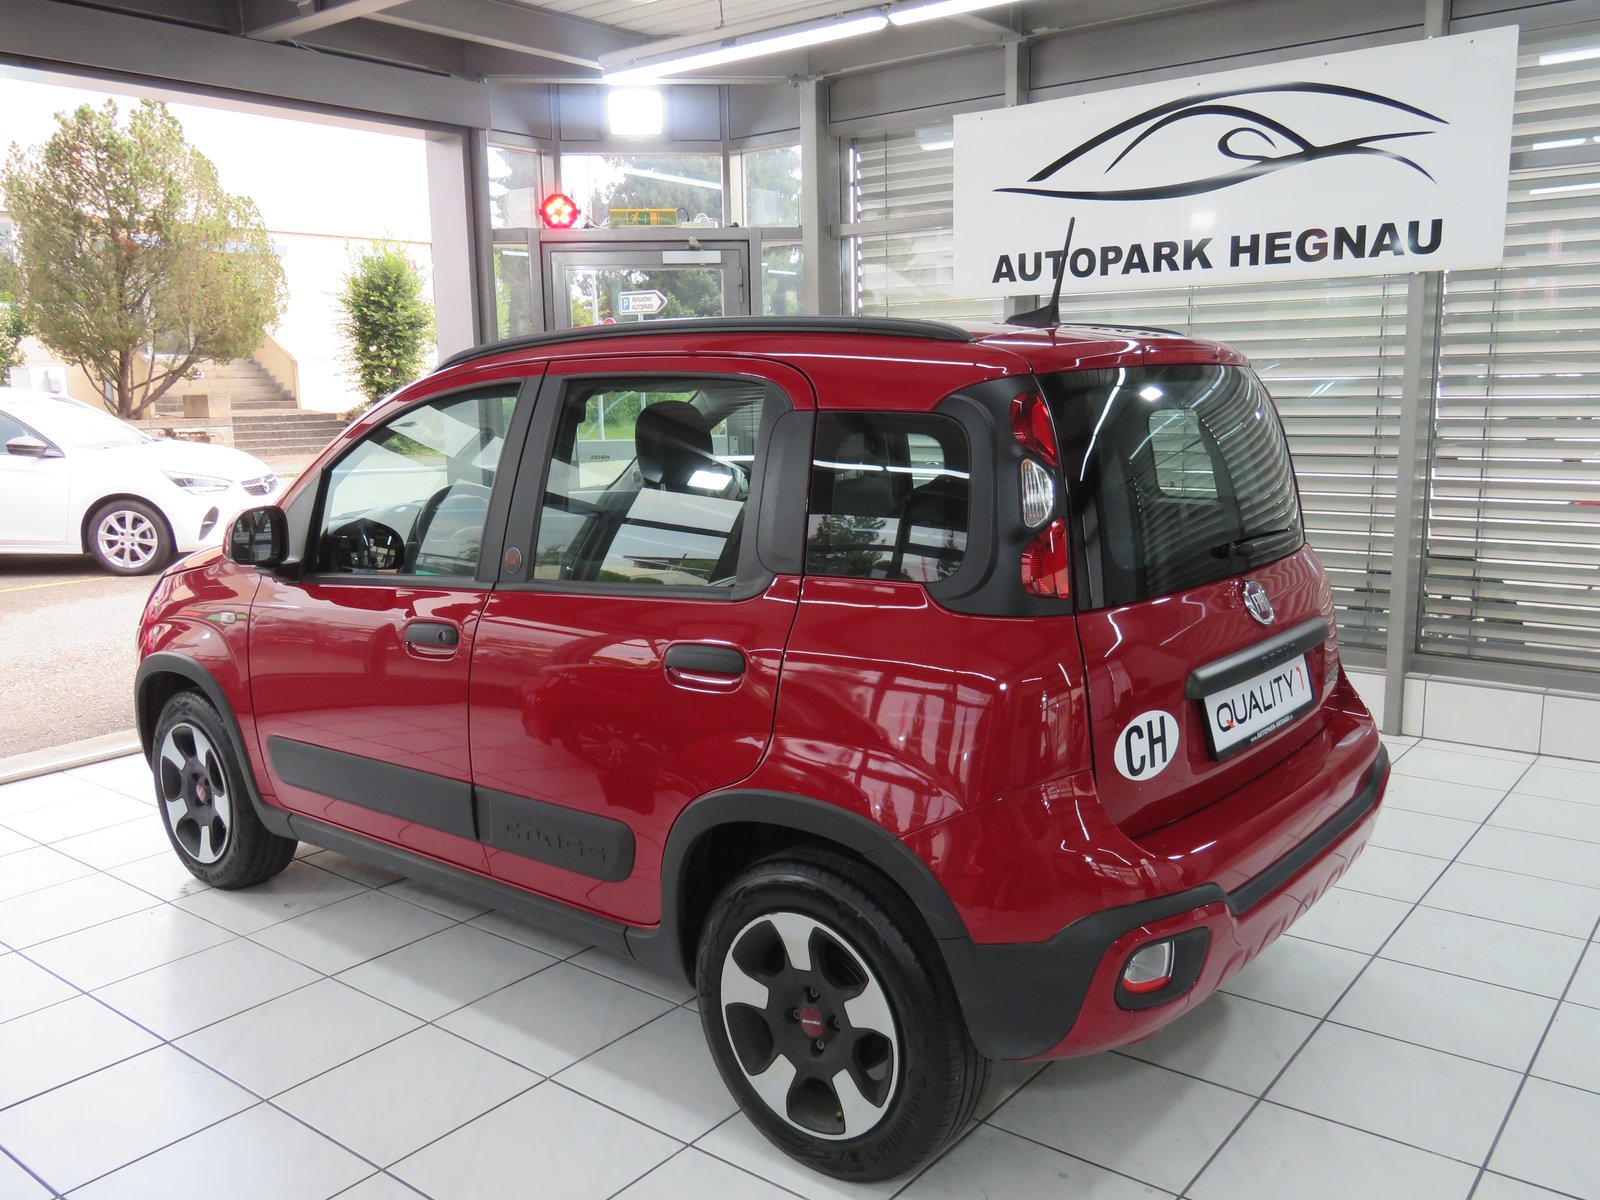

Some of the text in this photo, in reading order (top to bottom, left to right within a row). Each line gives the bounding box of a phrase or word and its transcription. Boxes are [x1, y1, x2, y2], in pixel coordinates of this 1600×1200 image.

[991, 218, 1444, 284] AUTOPARK HEGNAU
[1216, 669, 1294, 733] QUALITY
[1295, 666, 1305, 691] 1
[1124, 714, 1168, 778] CH
